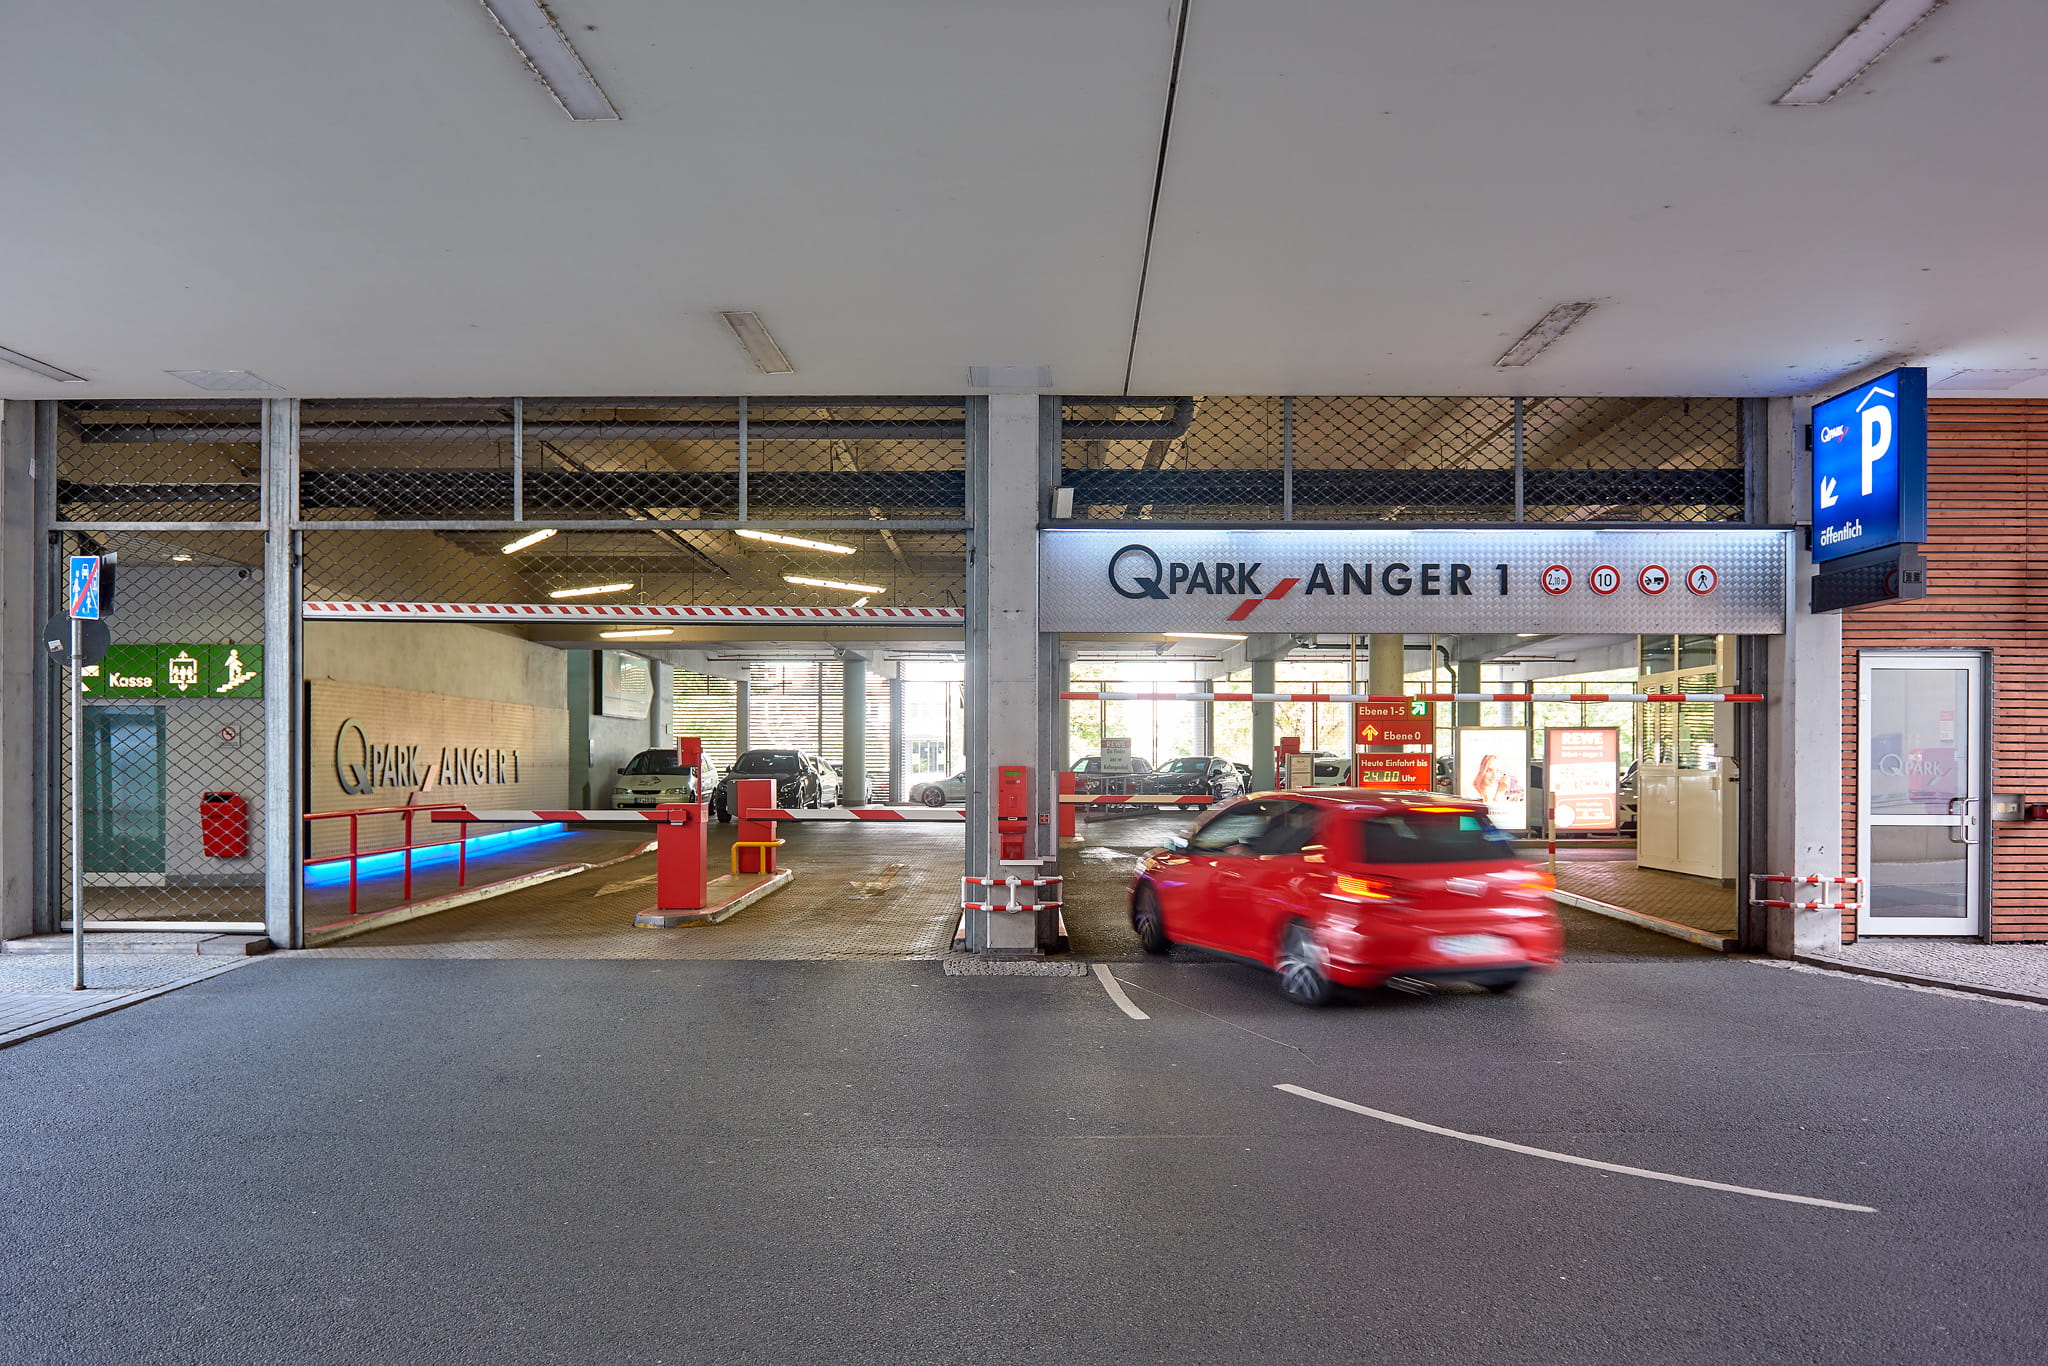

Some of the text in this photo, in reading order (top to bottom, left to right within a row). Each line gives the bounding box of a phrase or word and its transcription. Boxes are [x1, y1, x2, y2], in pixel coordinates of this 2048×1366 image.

[1861, 404, 1893, 497] P
[1820, 518, 1863, 547] öffentlich
[1304, 562, 1473, 596] ANGER
[1495, 563, 1509, 596] 1
[1597, 572, 1613, 588] 10
[109, 671, 153, 688] Kasse
[1359, 706, 1405, 716] Ebene 1-5
[1384, 731, 1422, 741] Ebene 0
[1561, 732, 1604, 745] REWE
[439, 747, 508, 786] ANGER
[513, 749, 521, 784] 1
[1361, 759, 1428, 767] Heute Einfahrt bis
[1401, 774, 1417, 782] Uhr
